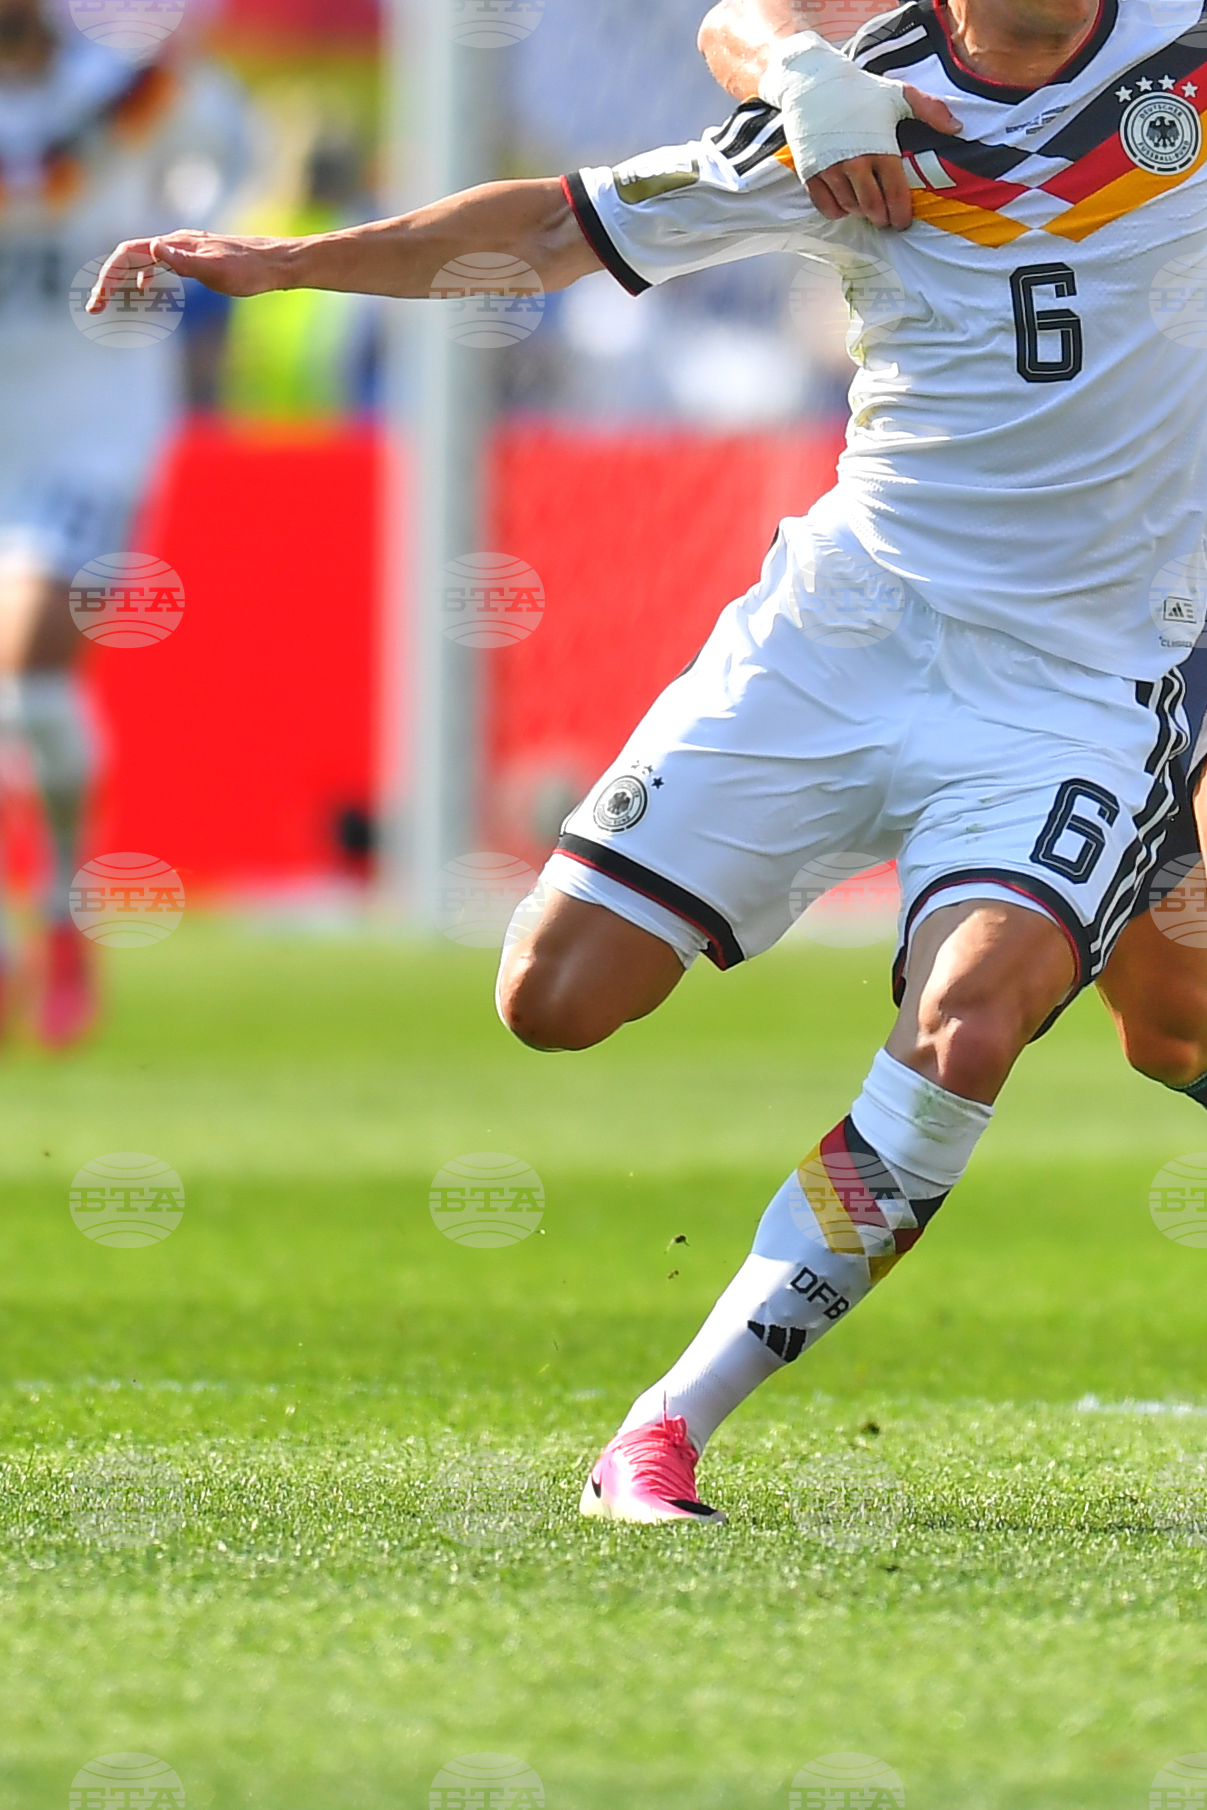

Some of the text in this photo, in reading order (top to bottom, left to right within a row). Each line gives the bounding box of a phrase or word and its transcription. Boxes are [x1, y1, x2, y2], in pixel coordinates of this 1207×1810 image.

[1139, 104, 1182, 119] DEUTSCHER
[1009, 261, 1083, 383] 6
[1028, 777, 1120, 885] 6
[790, 1266, 850, 1320] DFB
